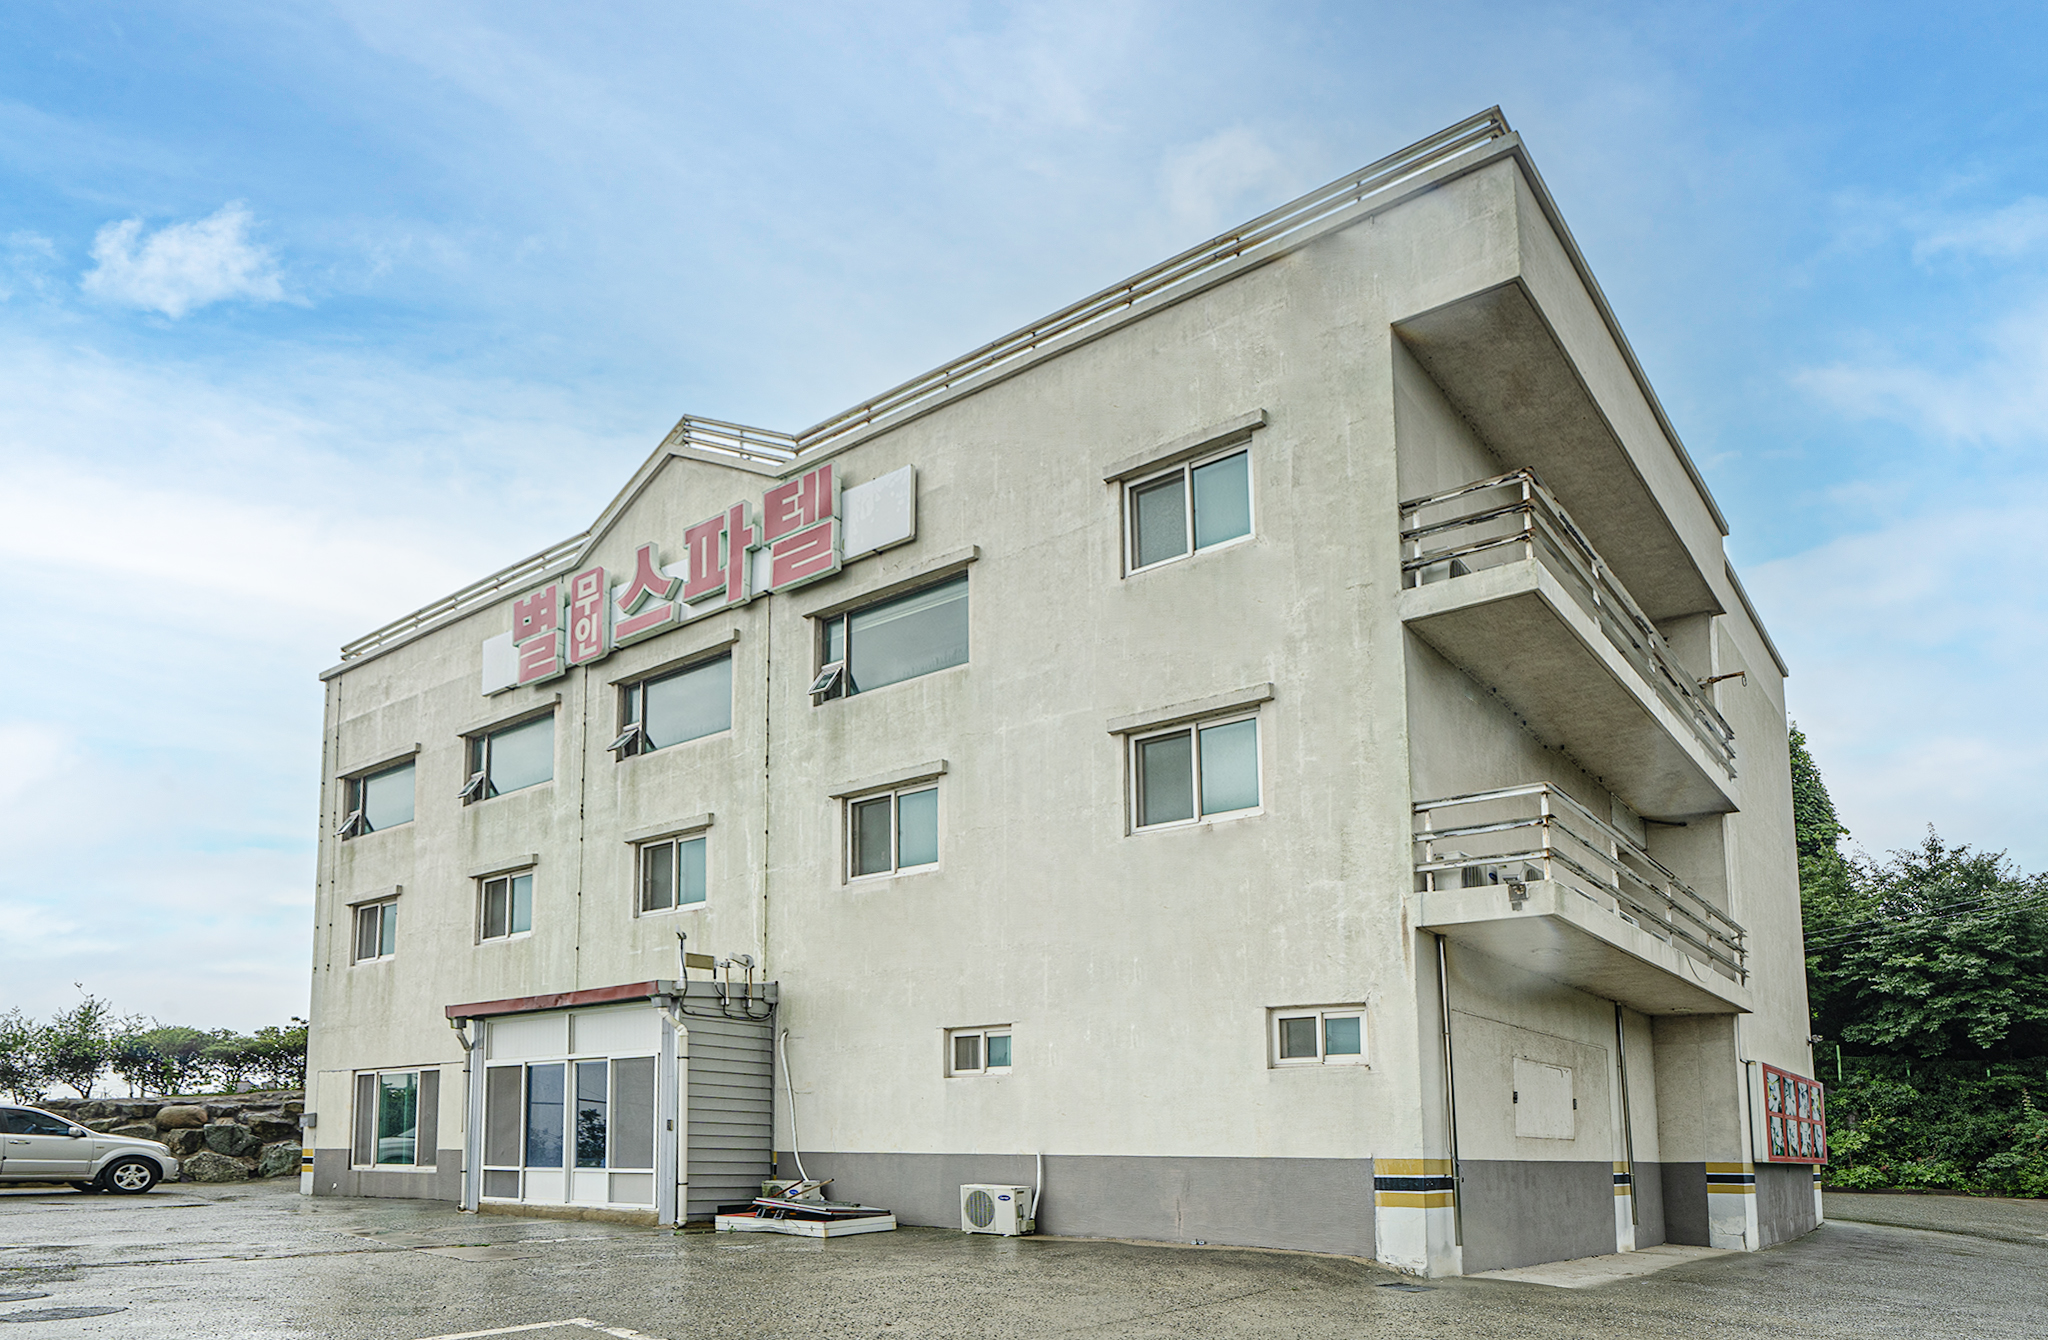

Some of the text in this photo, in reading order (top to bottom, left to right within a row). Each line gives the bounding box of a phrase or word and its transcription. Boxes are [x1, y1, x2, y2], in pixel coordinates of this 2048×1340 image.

[512, 463, 834, 686] 별 무인 스파텔
